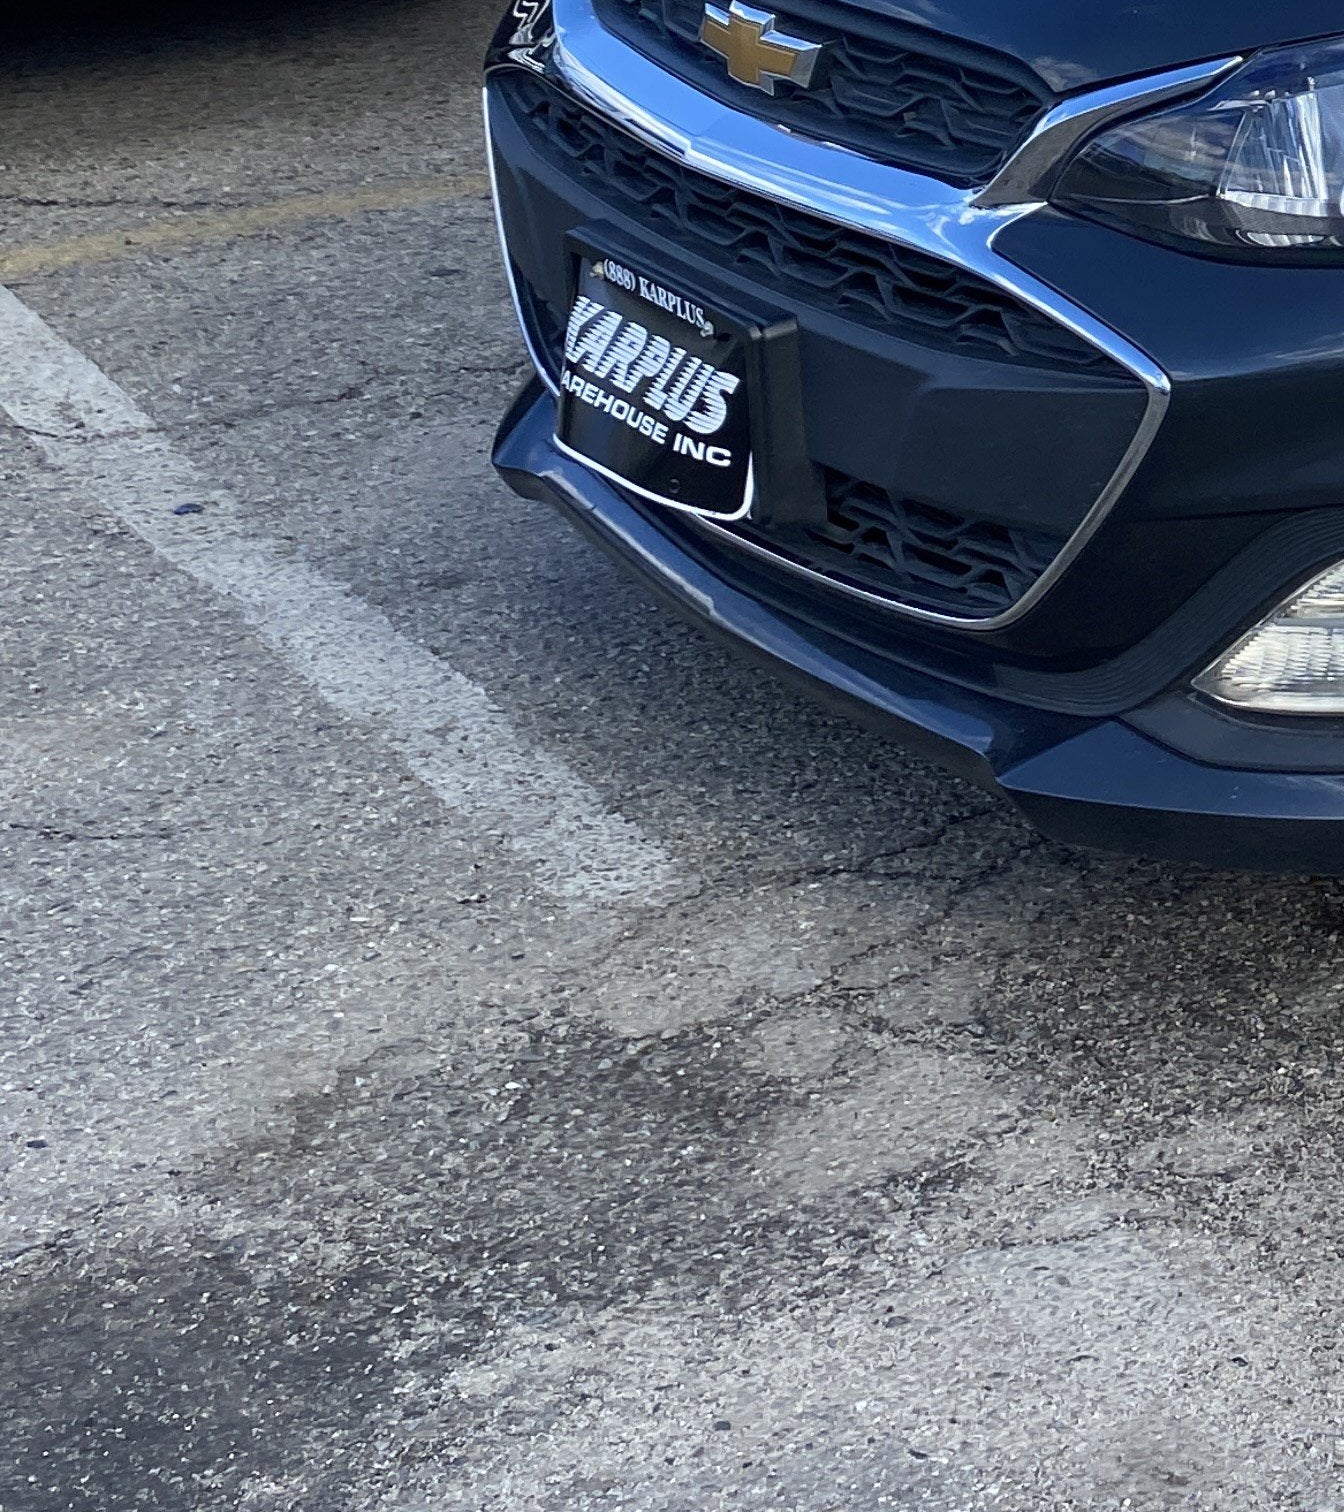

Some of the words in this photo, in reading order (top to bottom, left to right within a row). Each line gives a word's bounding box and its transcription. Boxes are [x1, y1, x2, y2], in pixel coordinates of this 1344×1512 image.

[603, 257, 636, 292] (888)
[638, 275, 706, 329] KARPLUS
[564, 295, 741, 435] KARPLUS
[561, 370, 669, 444] AREHOUSE
[673, 432, 732, 467] INC
